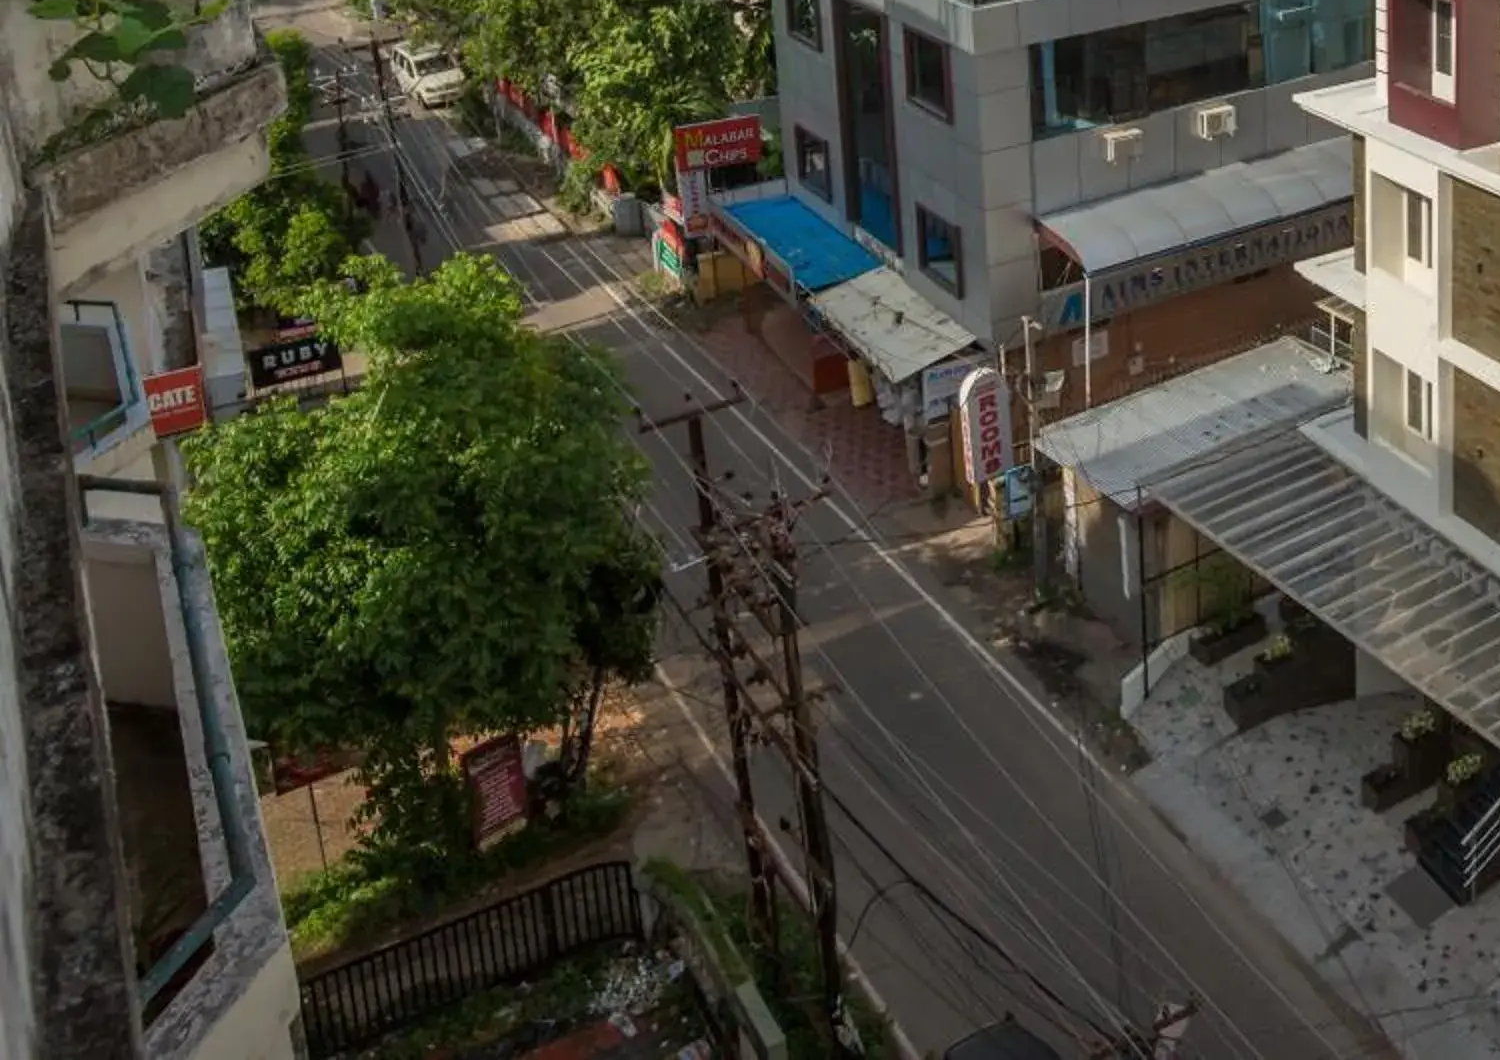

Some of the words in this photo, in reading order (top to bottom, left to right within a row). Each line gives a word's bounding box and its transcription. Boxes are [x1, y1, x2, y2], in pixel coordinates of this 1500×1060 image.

[685, 126, 754, 148] MALABAR
[1102, 267, 1164, 308] AIMS
[1174, 215, 1351, 287] INTERNATIONA
[263, 343, 328, 370] RUBY
[978, 394, 1002, 474] ROOMS
